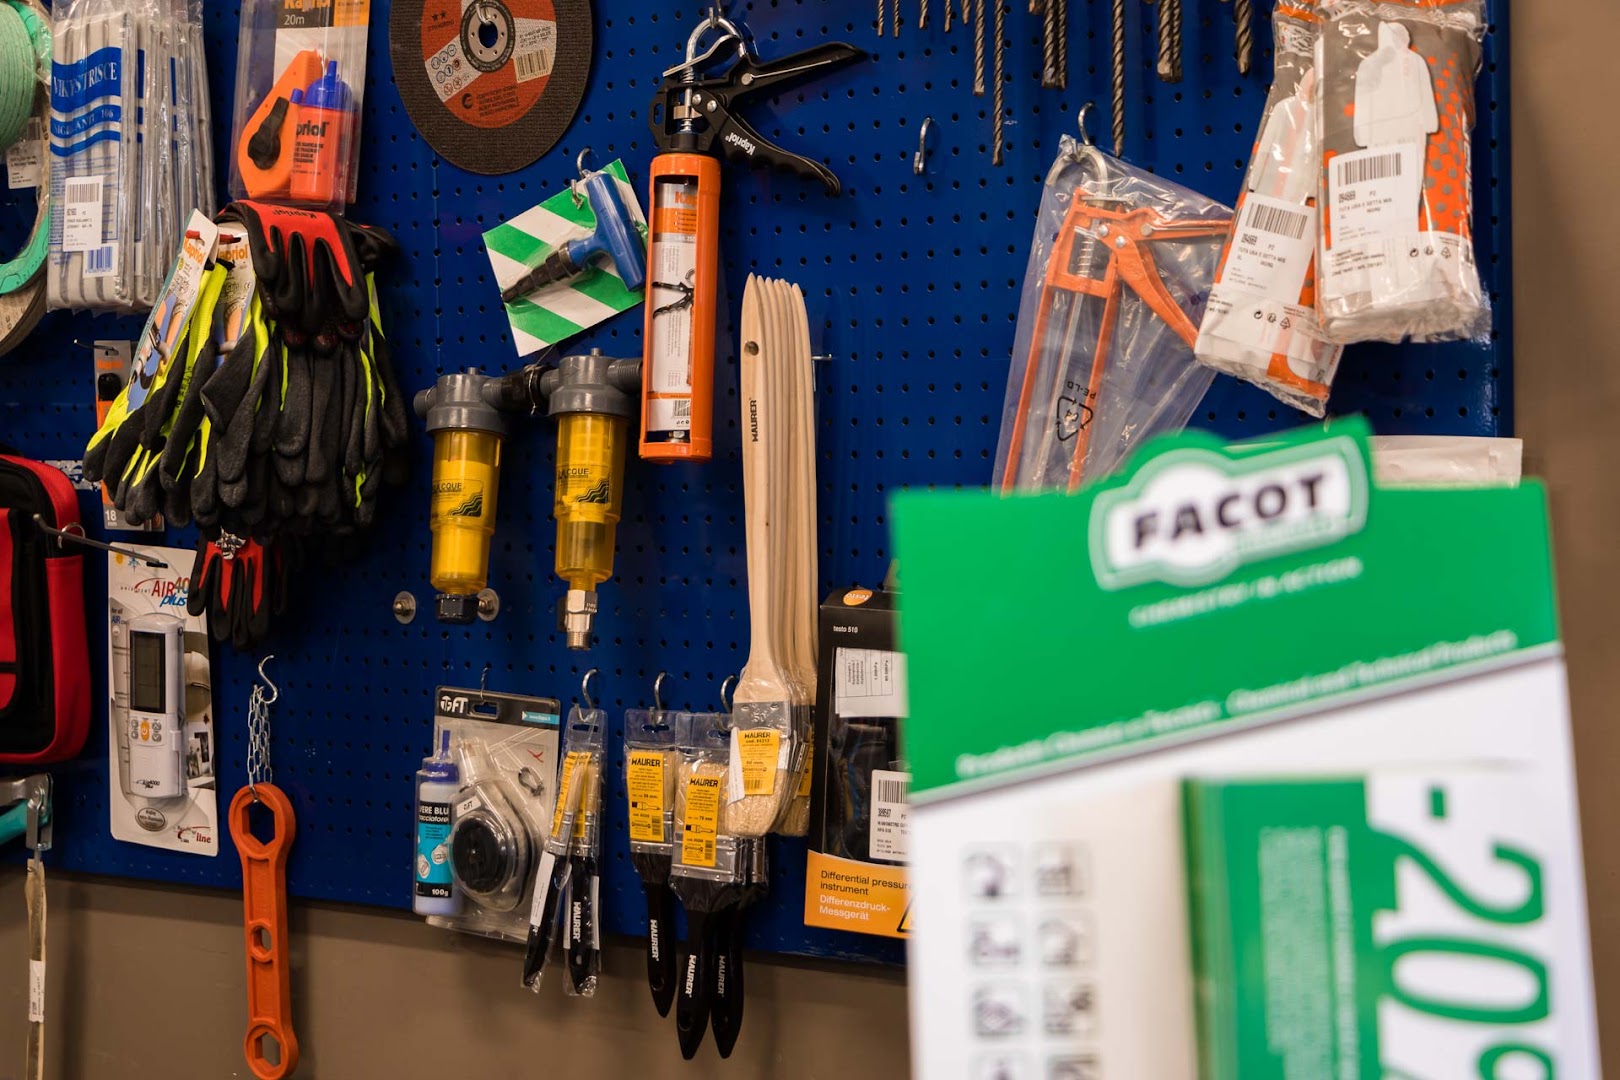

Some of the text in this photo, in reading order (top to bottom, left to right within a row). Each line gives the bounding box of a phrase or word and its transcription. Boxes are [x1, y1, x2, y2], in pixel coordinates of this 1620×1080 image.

[284, 14, 305, 25] 20m
[1067, 381, 1097, 399] PE-LD
[105, 509, 117, 521] 18
[1132, 474, 1326, 549] FACOT
[159, 594, 188, 608] plus
[833, 625, 847, 633] testo
[744, 731, 771, 739] MAURER
[631, 757, 661, 767] MAURER
[690, 778, 719, 788] MAURER
[434, 807, 449, 815] BLU
[820, 870, 870, 886] Differential
[432, 888, 449, 897] 100g
[820, 882, 869, 896] instrument
[819, 894, 891, 912] Differenzdruck-
[819, 905, 869, 921] Messgerät
[573, 901, 581, 941] MAURER
[650, 919, 659, 961] MAURER
[685, 954, 697, 997] MAURER
[717, 955, 726, 997] MAURER
